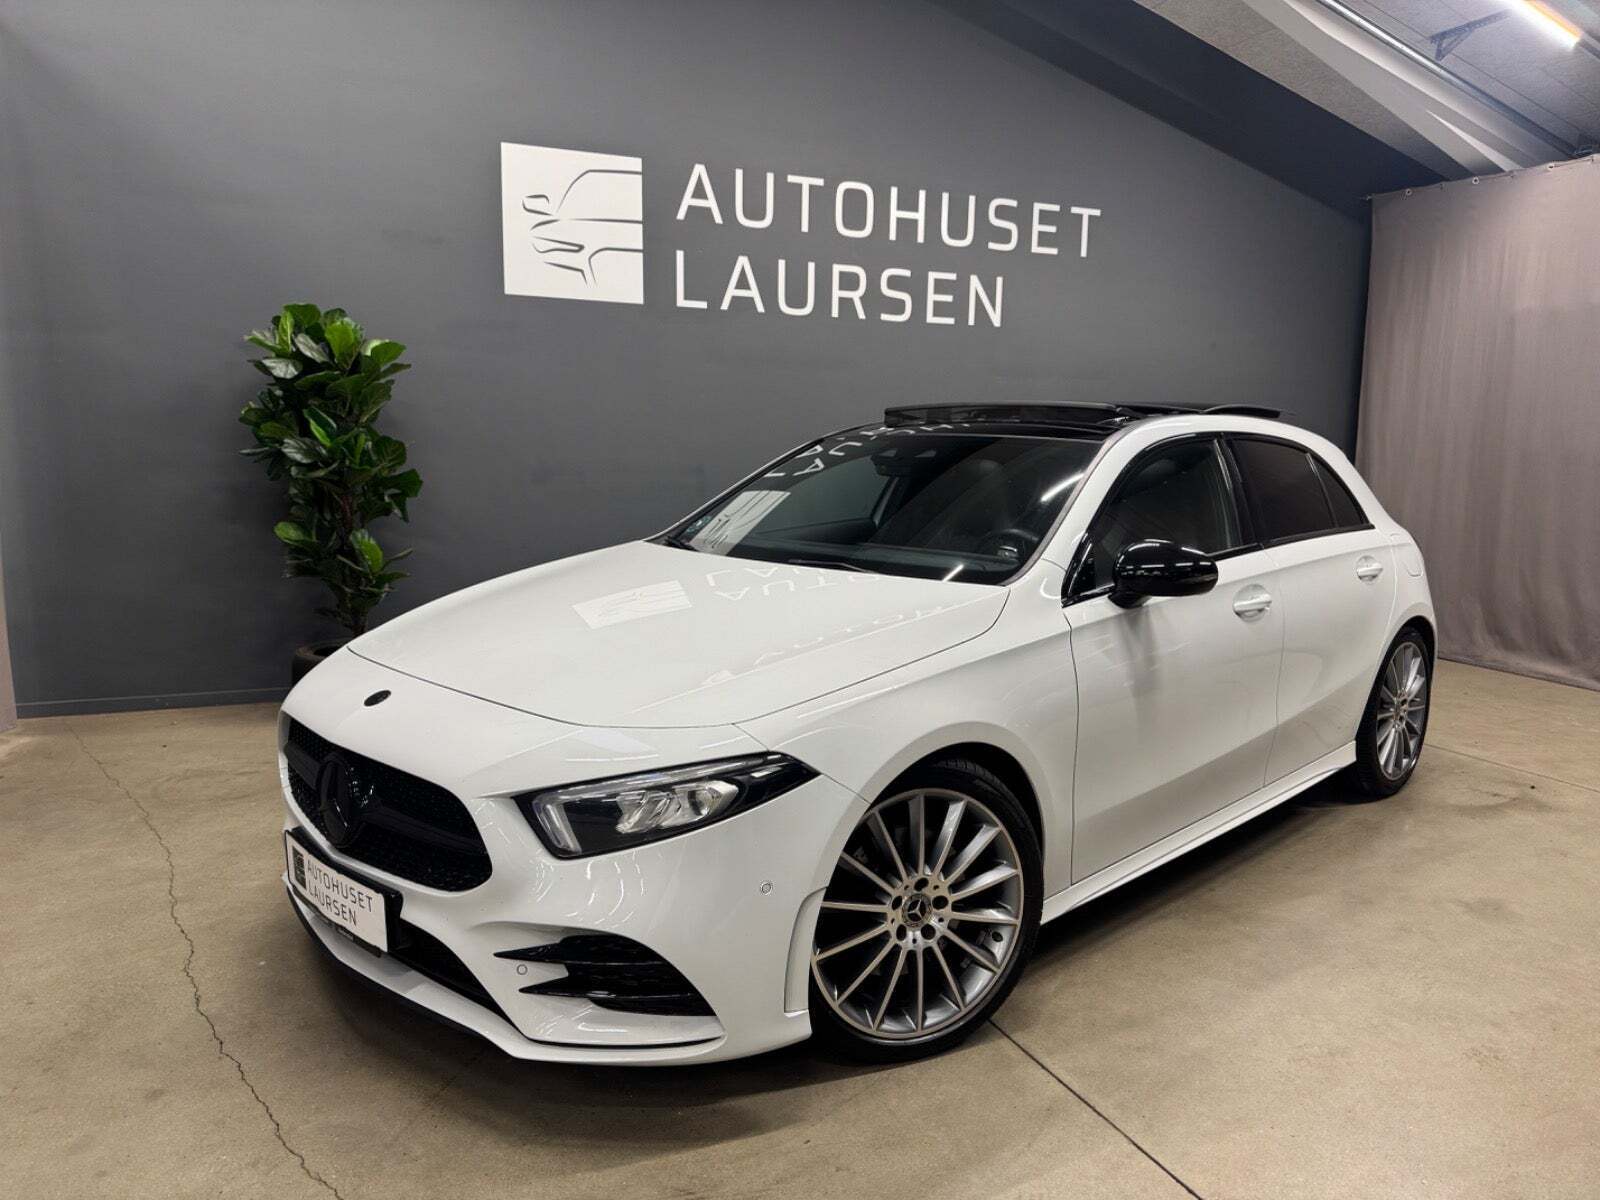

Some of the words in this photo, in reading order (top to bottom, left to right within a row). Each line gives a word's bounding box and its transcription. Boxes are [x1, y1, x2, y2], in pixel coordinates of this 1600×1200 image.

[676, 163, 1101, 258] AUTOHUSET
[675, 249, 1004, 328] LAURSEN
[307, 859, 373, 913] AUTOHUSET
[307, 880, 357, 927] LAURSEN
